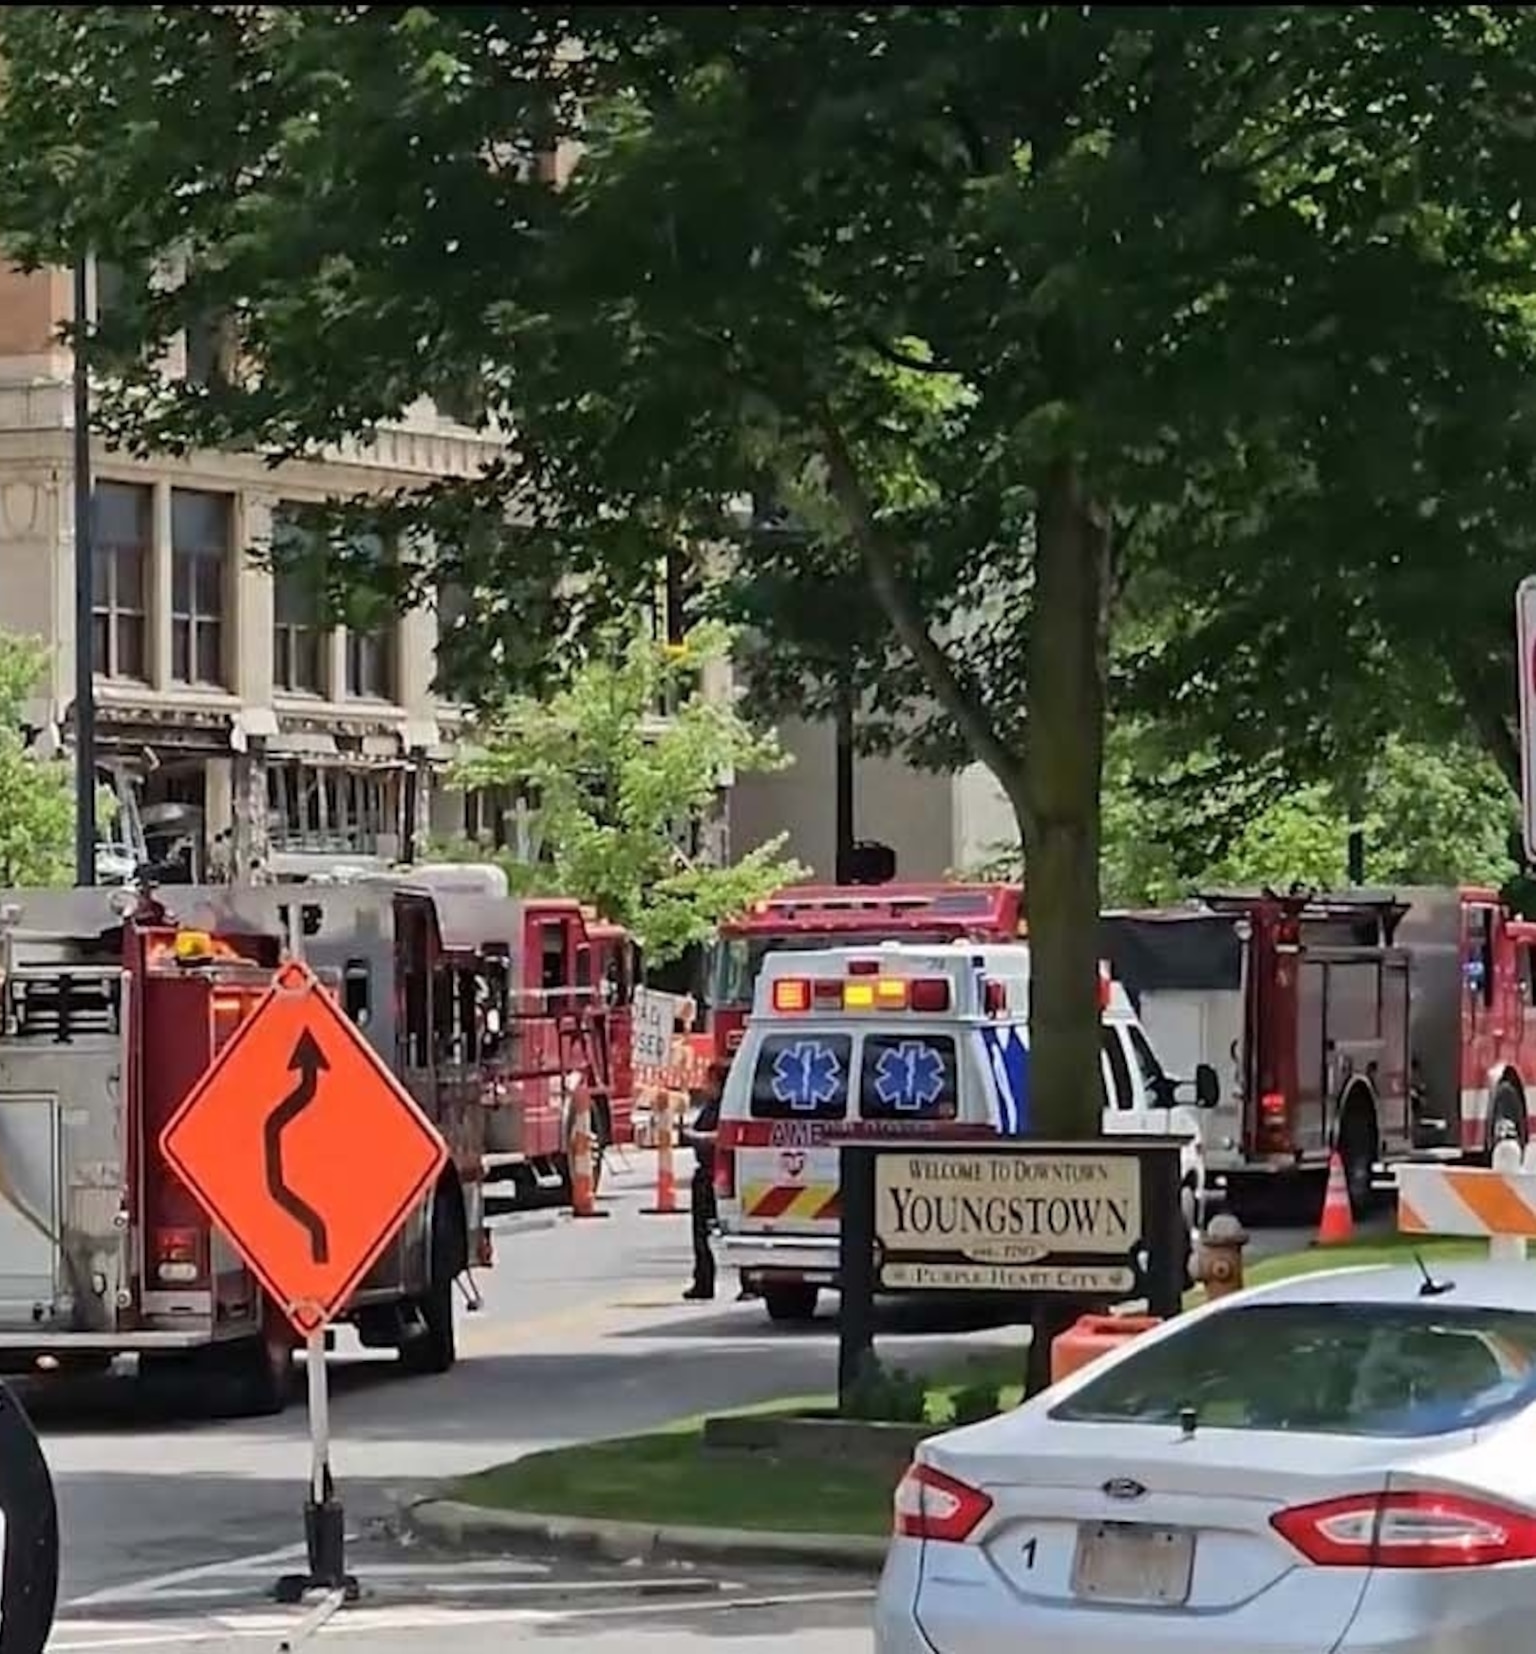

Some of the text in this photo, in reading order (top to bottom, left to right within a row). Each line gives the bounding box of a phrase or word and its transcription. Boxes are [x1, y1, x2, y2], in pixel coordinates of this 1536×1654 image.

[909, 1160, 1109, 1182] WELCOME TO DOWNTOWN
[889, 1187, 1129, 1236] YOUNGSTOWN
[990, 1269, 1048, 1285] HEART
[1057, 1270, 1099, 1287] CITY
[1021, 1537, 1037, 1569] 1
